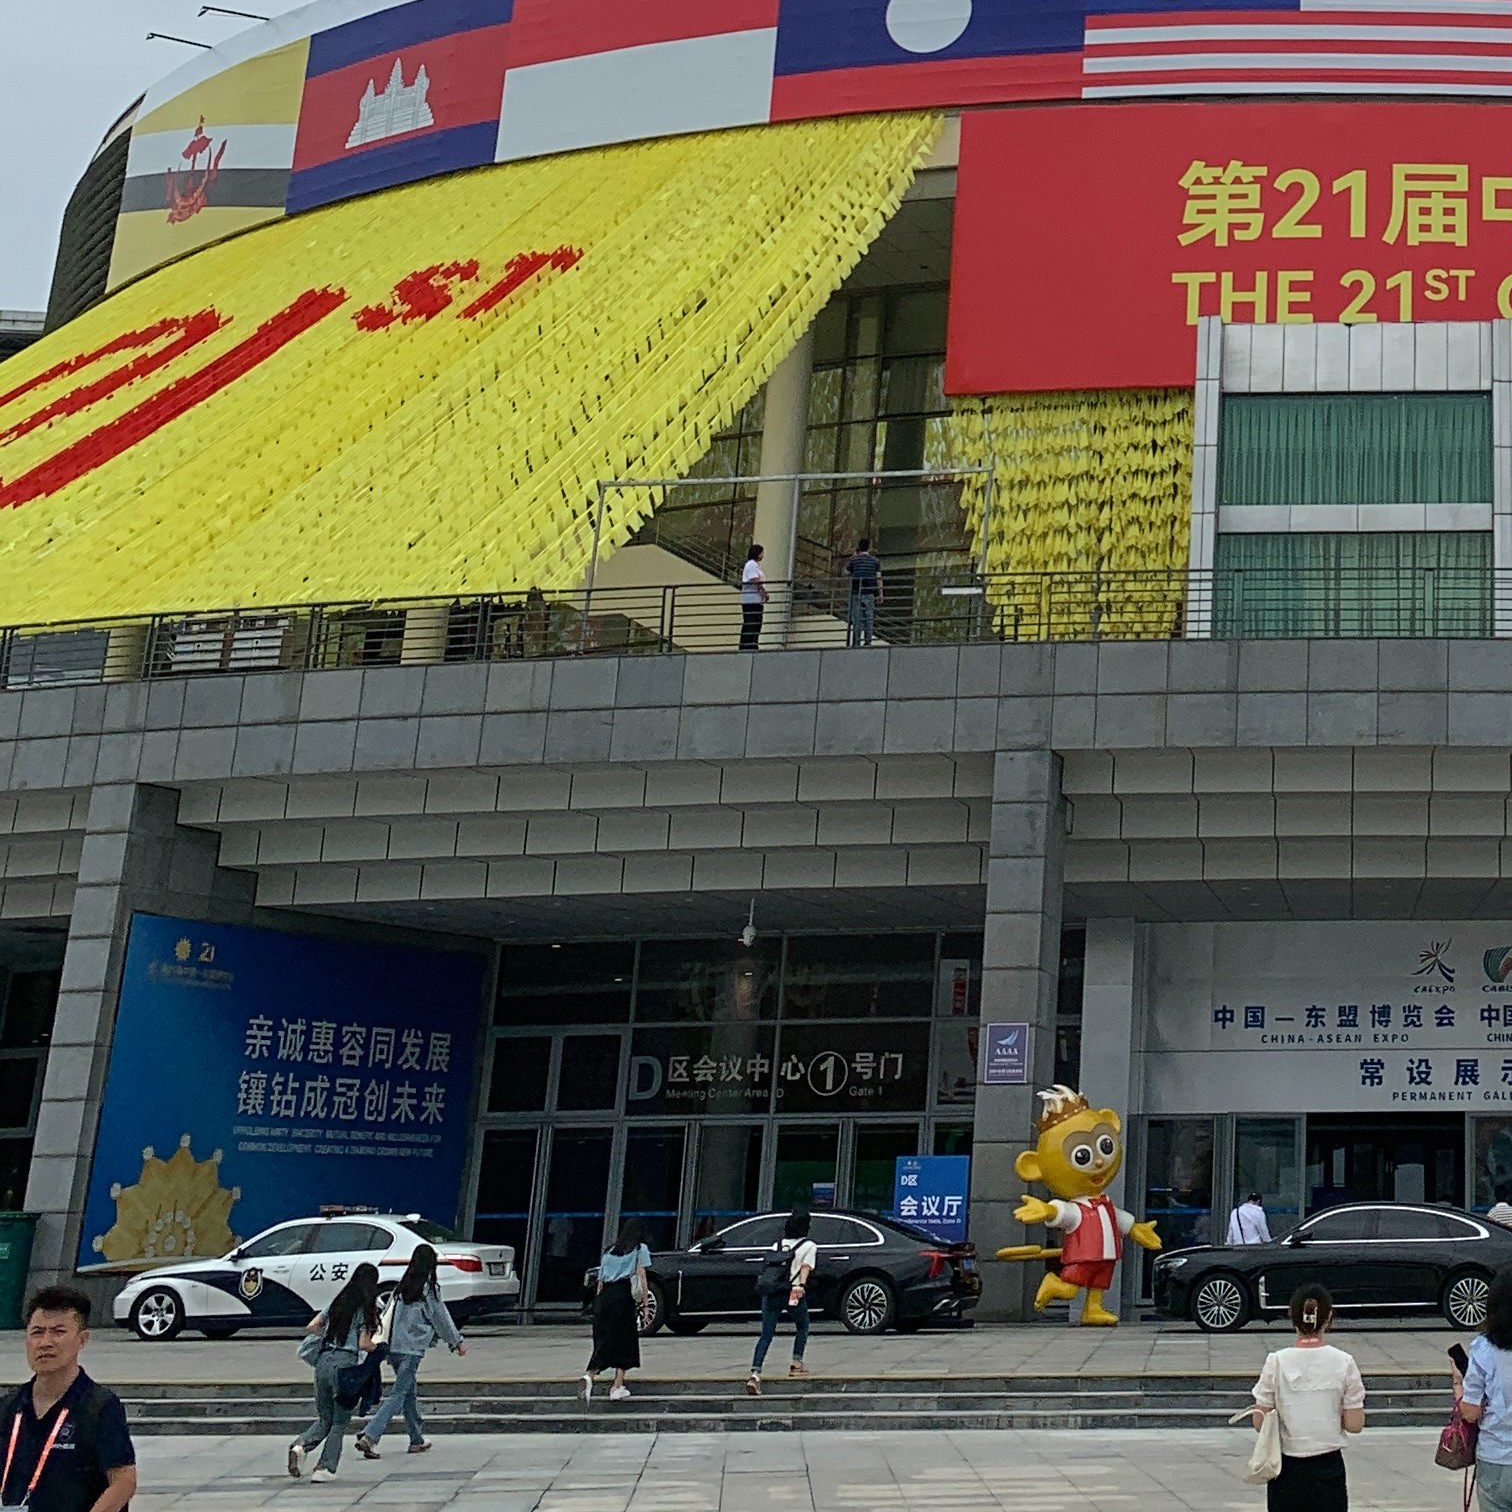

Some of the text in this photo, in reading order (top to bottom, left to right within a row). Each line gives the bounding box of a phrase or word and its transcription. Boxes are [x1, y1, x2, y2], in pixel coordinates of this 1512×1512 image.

[1171, 271, 1314, 326] THE
[244, 1014, 452, 1073] 亲诚惠容同发展
[1373, 1033, 1410, 1044] EXPO
[236, 1069, 446, 1125] 镶钻成冠创未来
[848, 1085, 875, 1097] Gate
[1392, 1091, 1474, 1101] PERMANENT
[900, 1194, 963, 1217] 会议厅
[309, 1262, 349, 1281] 公安
